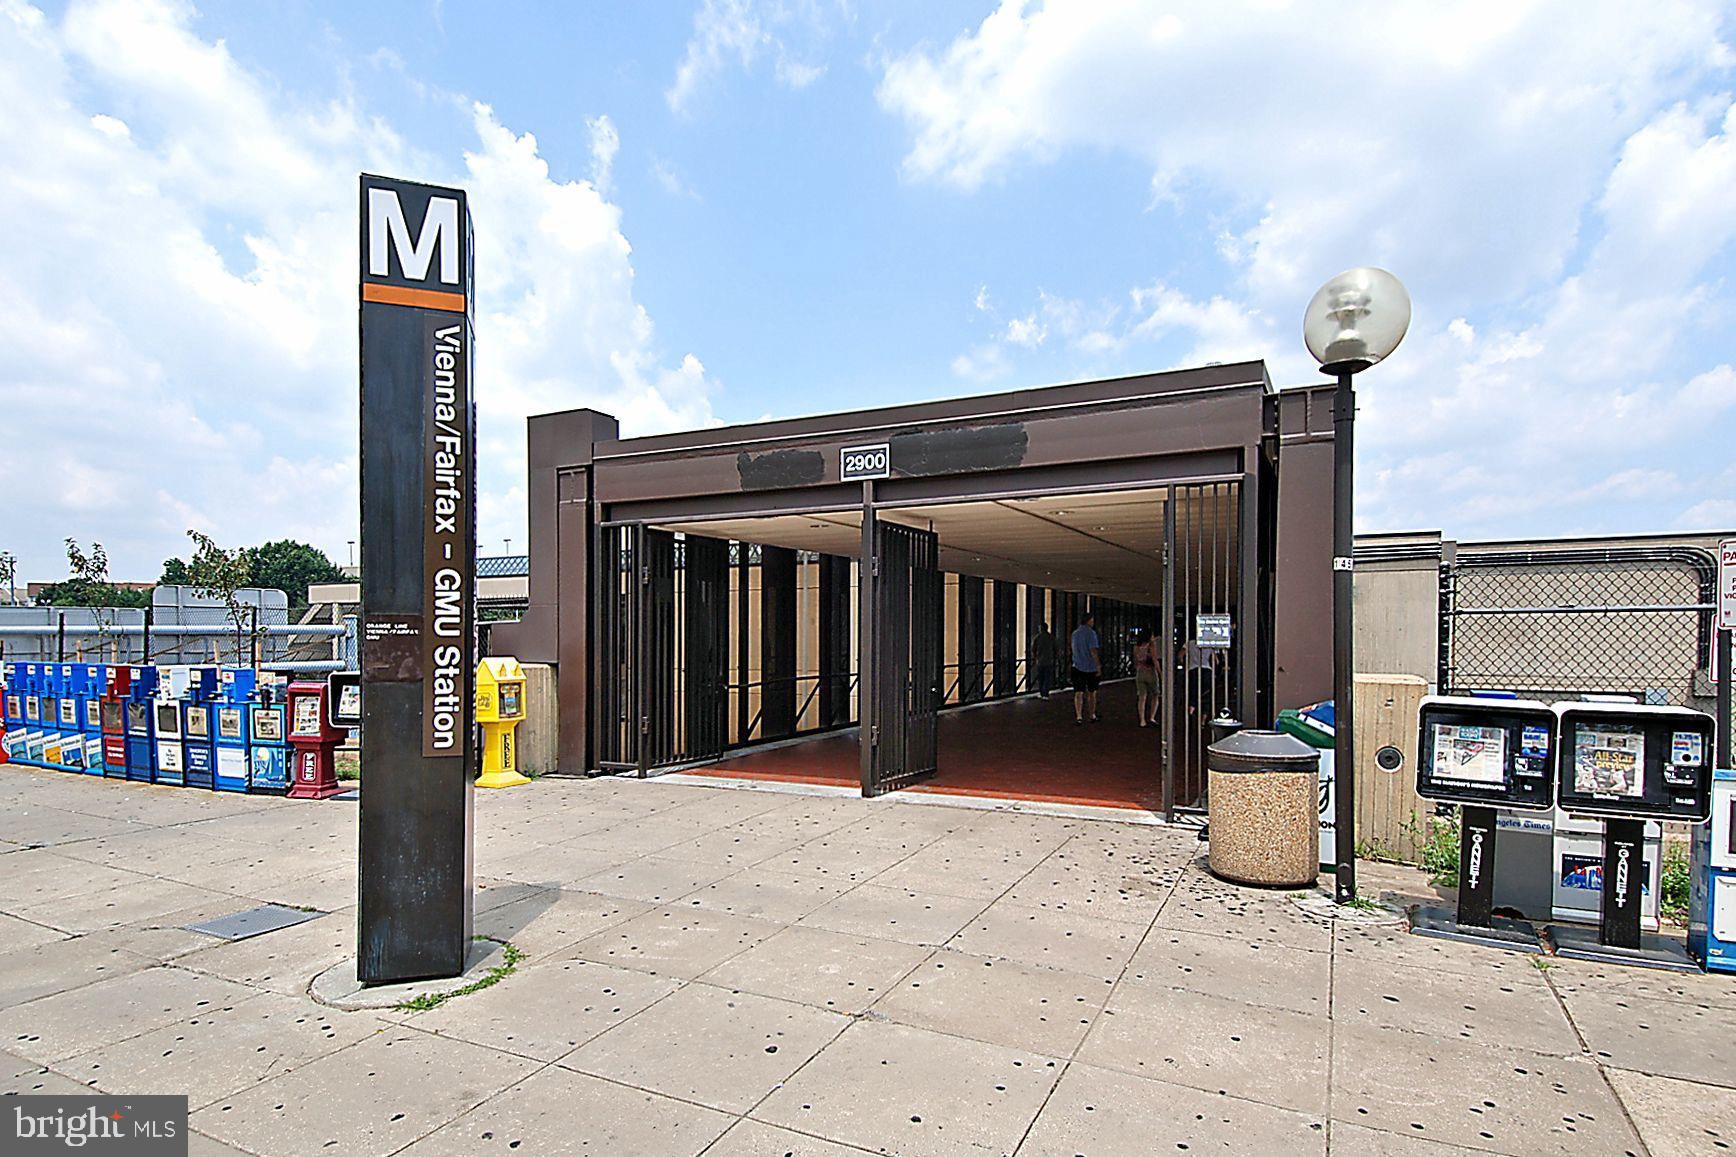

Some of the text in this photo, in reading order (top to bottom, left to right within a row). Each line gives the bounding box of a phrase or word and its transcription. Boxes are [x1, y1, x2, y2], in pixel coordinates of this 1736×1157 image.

[368, 187, 460, 285] M
[434, 325, 461, 533] Vienna/Fairfax
[845, 452, 886, 472] 2900
[434, 568, 461, 637] GMU
[433, 646, 461, 749] Station
[1595, 750, 1635, 763] All-Star
[1524, 820, 1551, 830] Times
